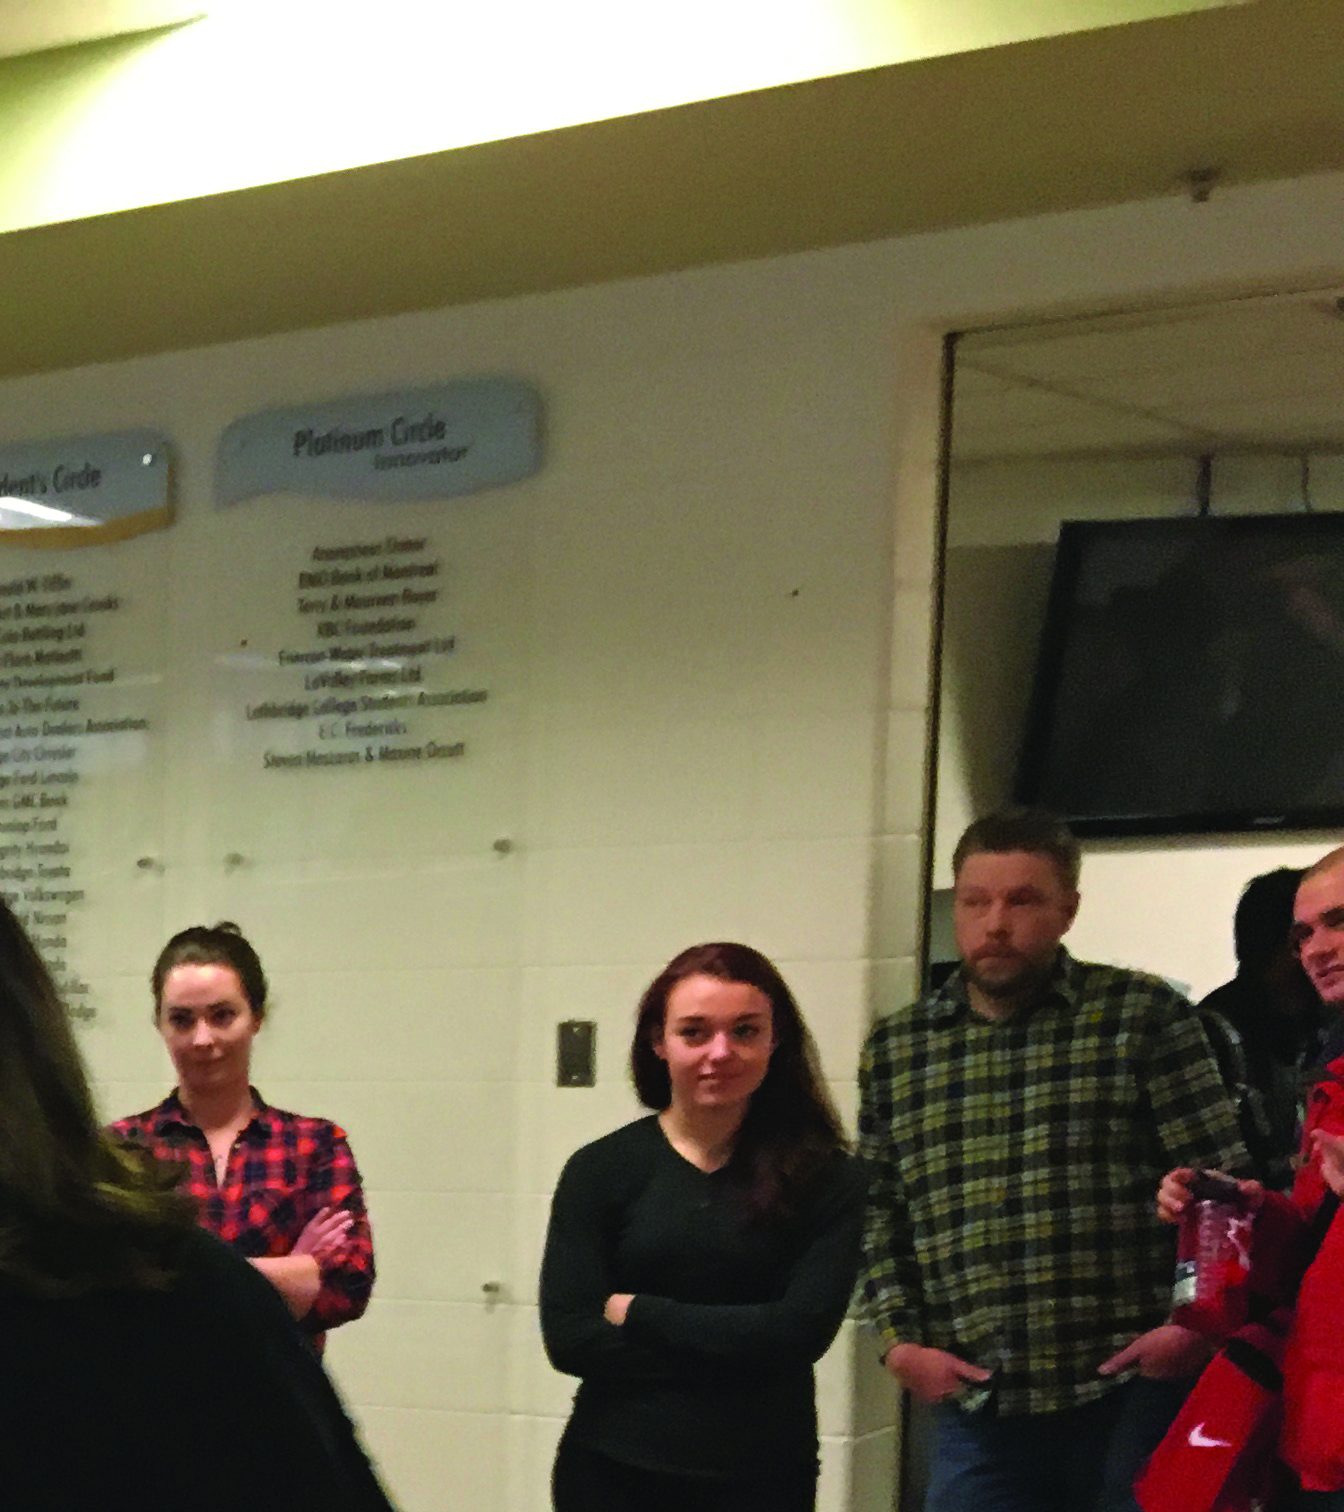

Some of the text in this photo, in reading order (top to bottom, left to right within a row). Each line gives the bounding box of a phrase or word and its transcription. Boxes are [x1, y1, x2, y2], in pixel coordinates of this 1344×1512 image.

[293, 412, 447, 457] Platinum Circle
[53, 462, 102, 494] Circle
[330, 594, 339, 612] &
[246, 702, 309, 721] Lethbridge
[365, 746, 374, 763] &
